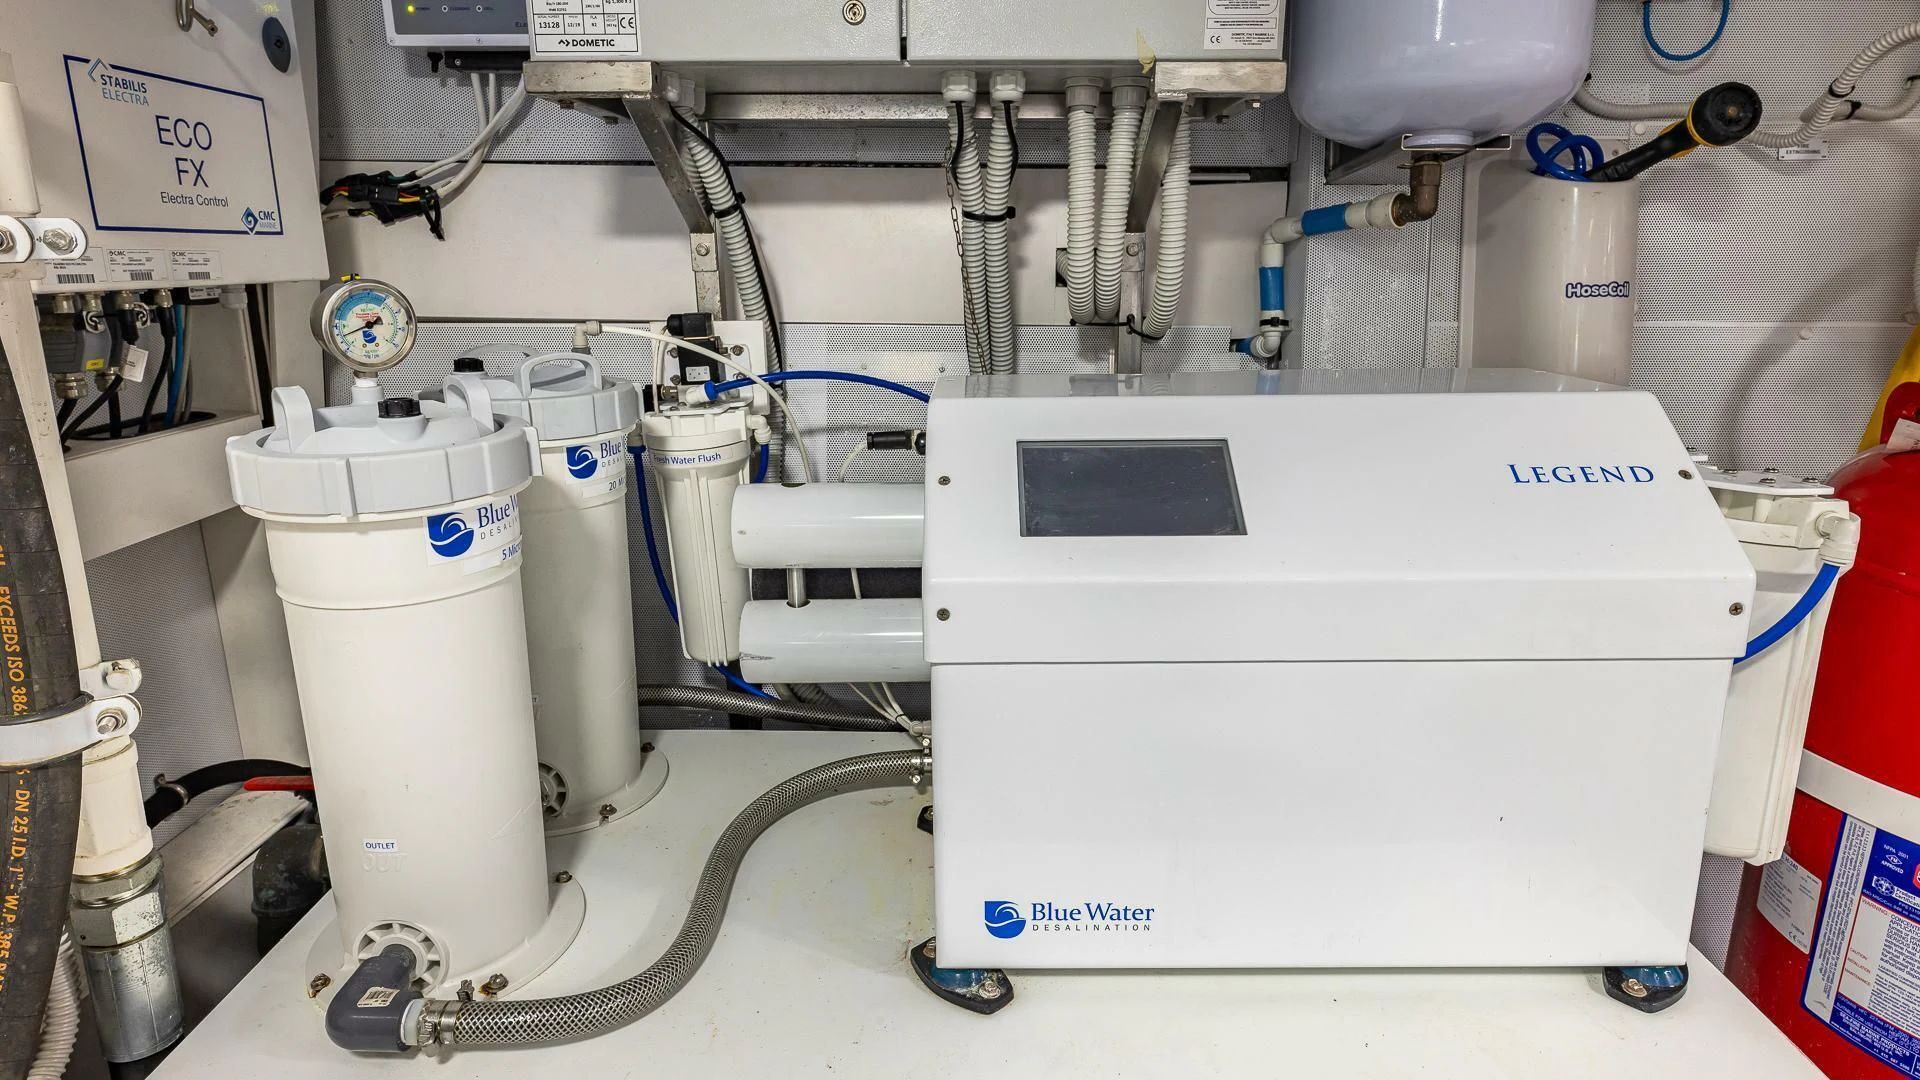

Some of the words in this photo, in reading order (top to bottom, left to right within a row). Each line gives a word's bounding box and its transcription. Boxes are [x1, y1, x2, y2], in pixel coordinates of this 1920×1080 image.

[572, 39, 615, 47] DOMETIC
[100, 74, 147, 94] STABILIS
[102, 88, 149, 107] ELECTRA
[155, 115, 212, 150] ECO
[175, 157, 209, 188] FX
[160, 192, 194, 205] Electra
[196, 194, 229, 207] Control
[258, 210, 276, 220] CMC
[1566, 281, 1630, 298] HoseCoil
[600, 440, 622, 459] Blue
[654, 455, 670, 464] Fresh
[671, 456, 695, 465] Water
[698, 452, 721, 463] Flush
[609, 481, 617, 491] 20
[476, 503, 510, 528] Blue
[502, 549, 506, 560] 5
[0, 586, 20, 653] EXCEEDS
[7, 656, 25, 682] ISO
[15, 790, 30, 812] DN
[14, 816, 29, 834] 25
[11, 838, 27, 859] I.D.
[1881, 860, 1904, 874] APPROVED
[1031, 902, 1081, 921] Blue
[1084, 902, 1154, 921] Water
[1862, 898, 1888, 916] WARNING
[1033, 924, 1151, 932] DESALINATION
[1860, 1025, 1880, 1039] MARINE
[1880, 1036, 1909, 1056] PRODUCTS
